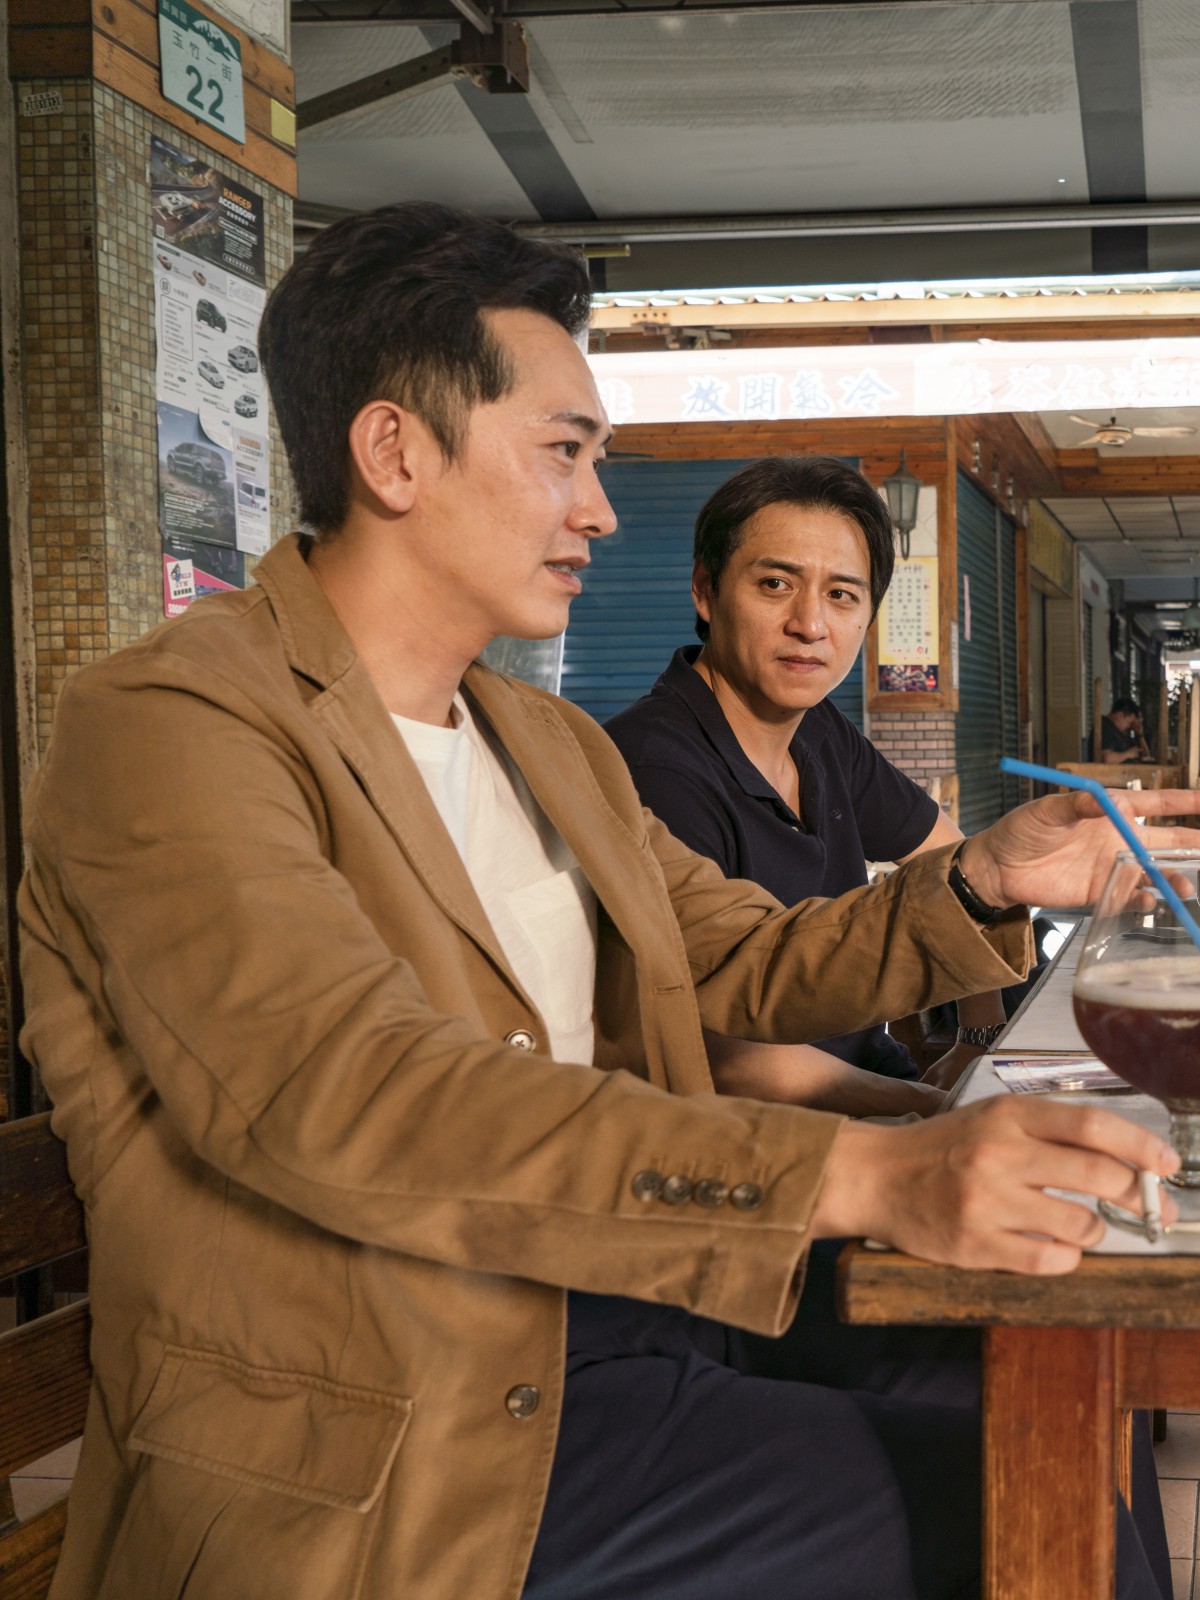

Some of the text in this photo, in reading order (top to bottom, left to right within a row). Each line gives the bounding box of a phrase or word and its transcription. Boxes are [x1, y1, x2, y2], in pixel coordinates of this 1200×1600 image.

[172, 30, 232, 82] 玉竹一街
[186, 65, 225, 123] 22
[218, 196, 256, 222] ACCESSORY
